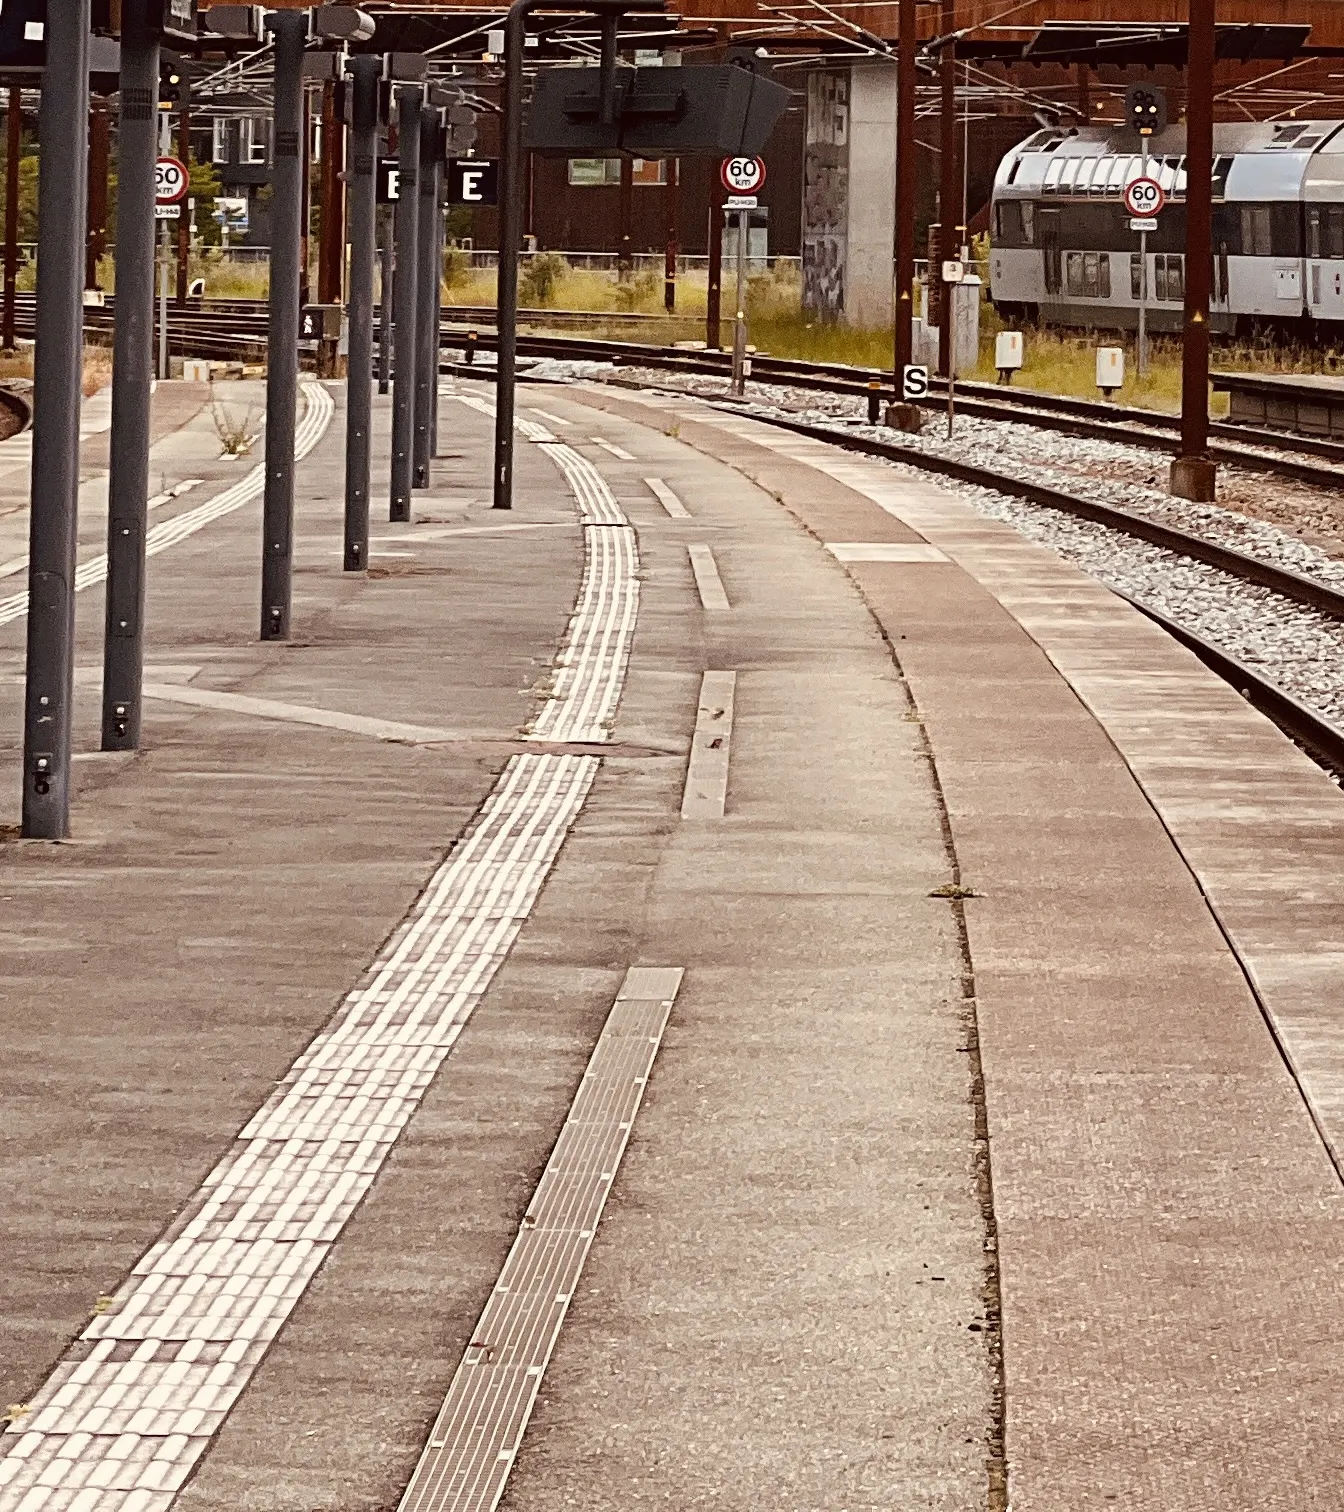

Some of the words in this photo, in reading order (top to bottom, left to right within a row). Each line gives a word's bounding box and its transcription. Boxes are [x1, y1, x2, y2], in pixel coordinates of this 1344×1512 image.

[730, 160, 757, 177] 60
[462, 171, 483, 201] E
[735, 178, 751, 186] km
[1132, 185, 1157, 201] 60
[1136, 201, 1152, 210] km
[904, 368, 927, 395] S
